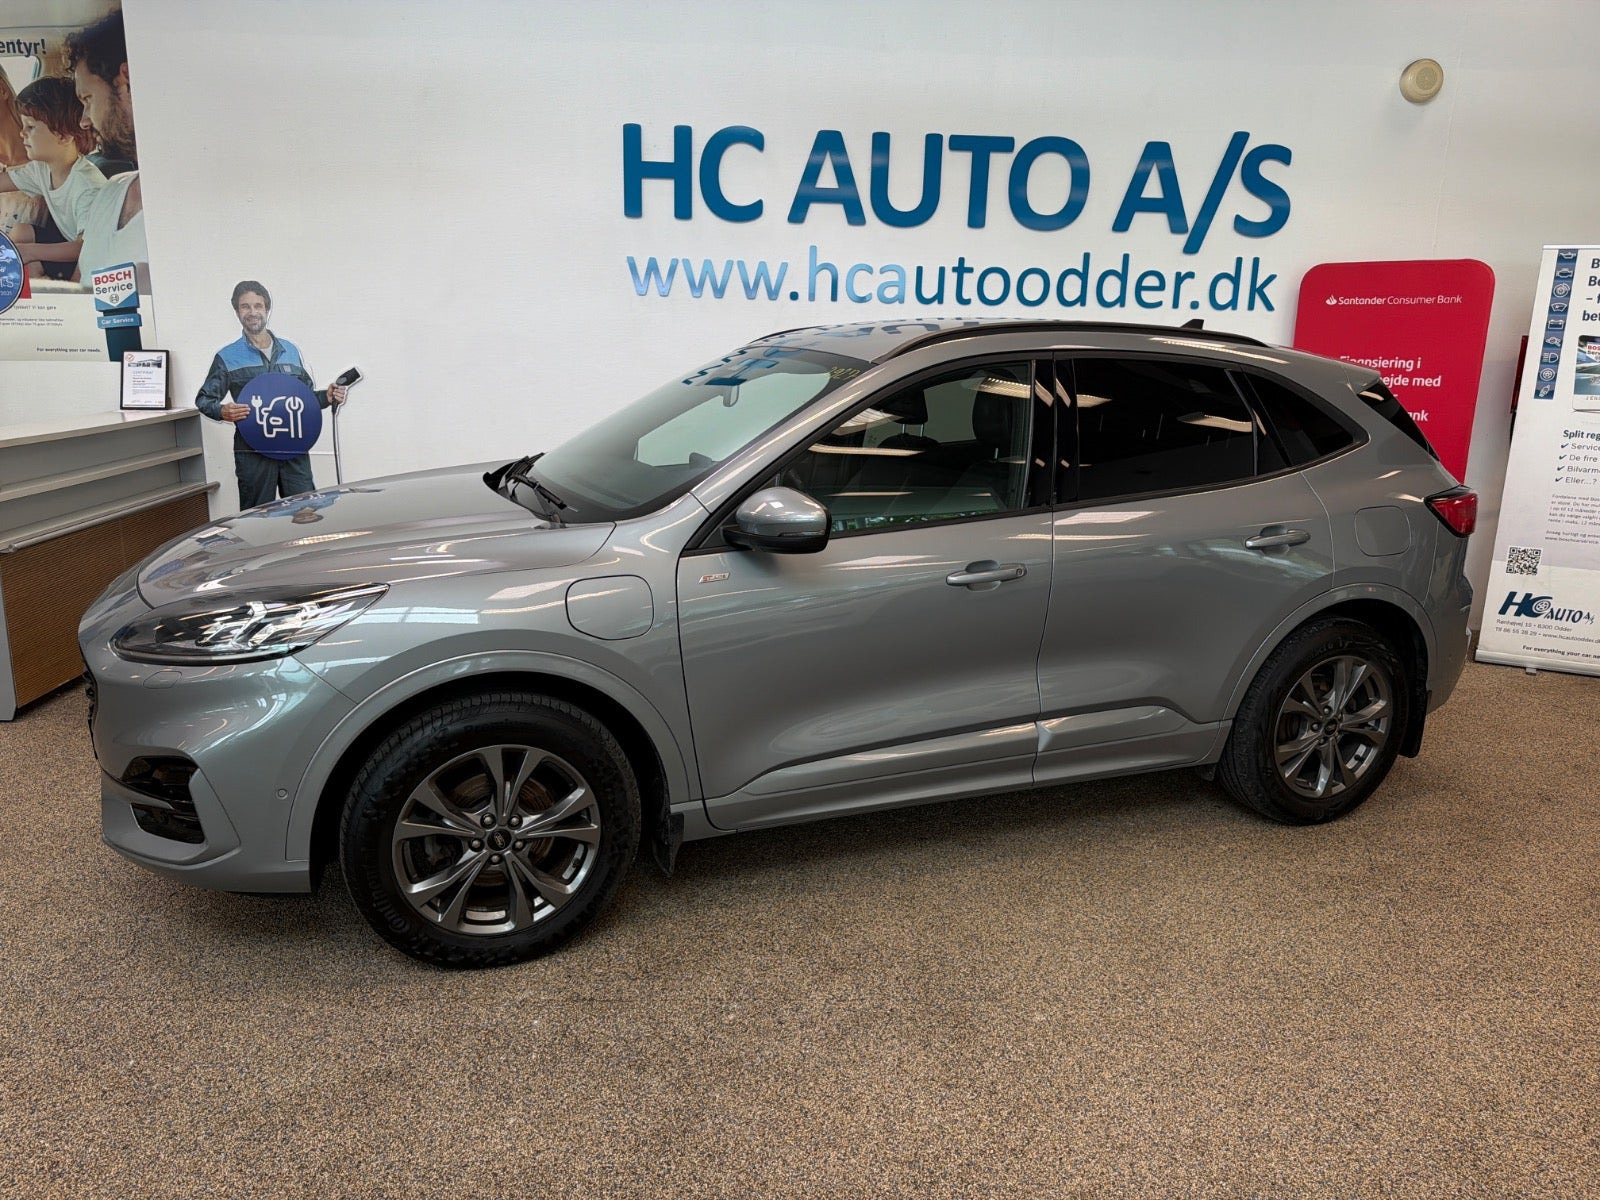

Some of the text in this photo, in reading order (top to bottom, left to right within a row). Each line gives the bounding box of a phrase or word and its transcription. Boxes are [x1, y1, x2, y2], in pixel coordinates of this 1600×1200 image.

[623, 123, 1292, 254] HC AUTO A/S
[94, 270, 132, 285] BOSCH
[626, 245, 1278, 313] www.hcautoodder.dk
[95, 283, 133, 295] Service
[1338, 294, 1463, 305] Santander Consumer Bank
[1340, 356, 1421, 372] nsiering i
[1412, 375, 1442, 387] med
[1563, 429, 1584, 439] Split
[1544, 607, 1584, 624] AUTO
[1534, 647, 1566, 656] everything
